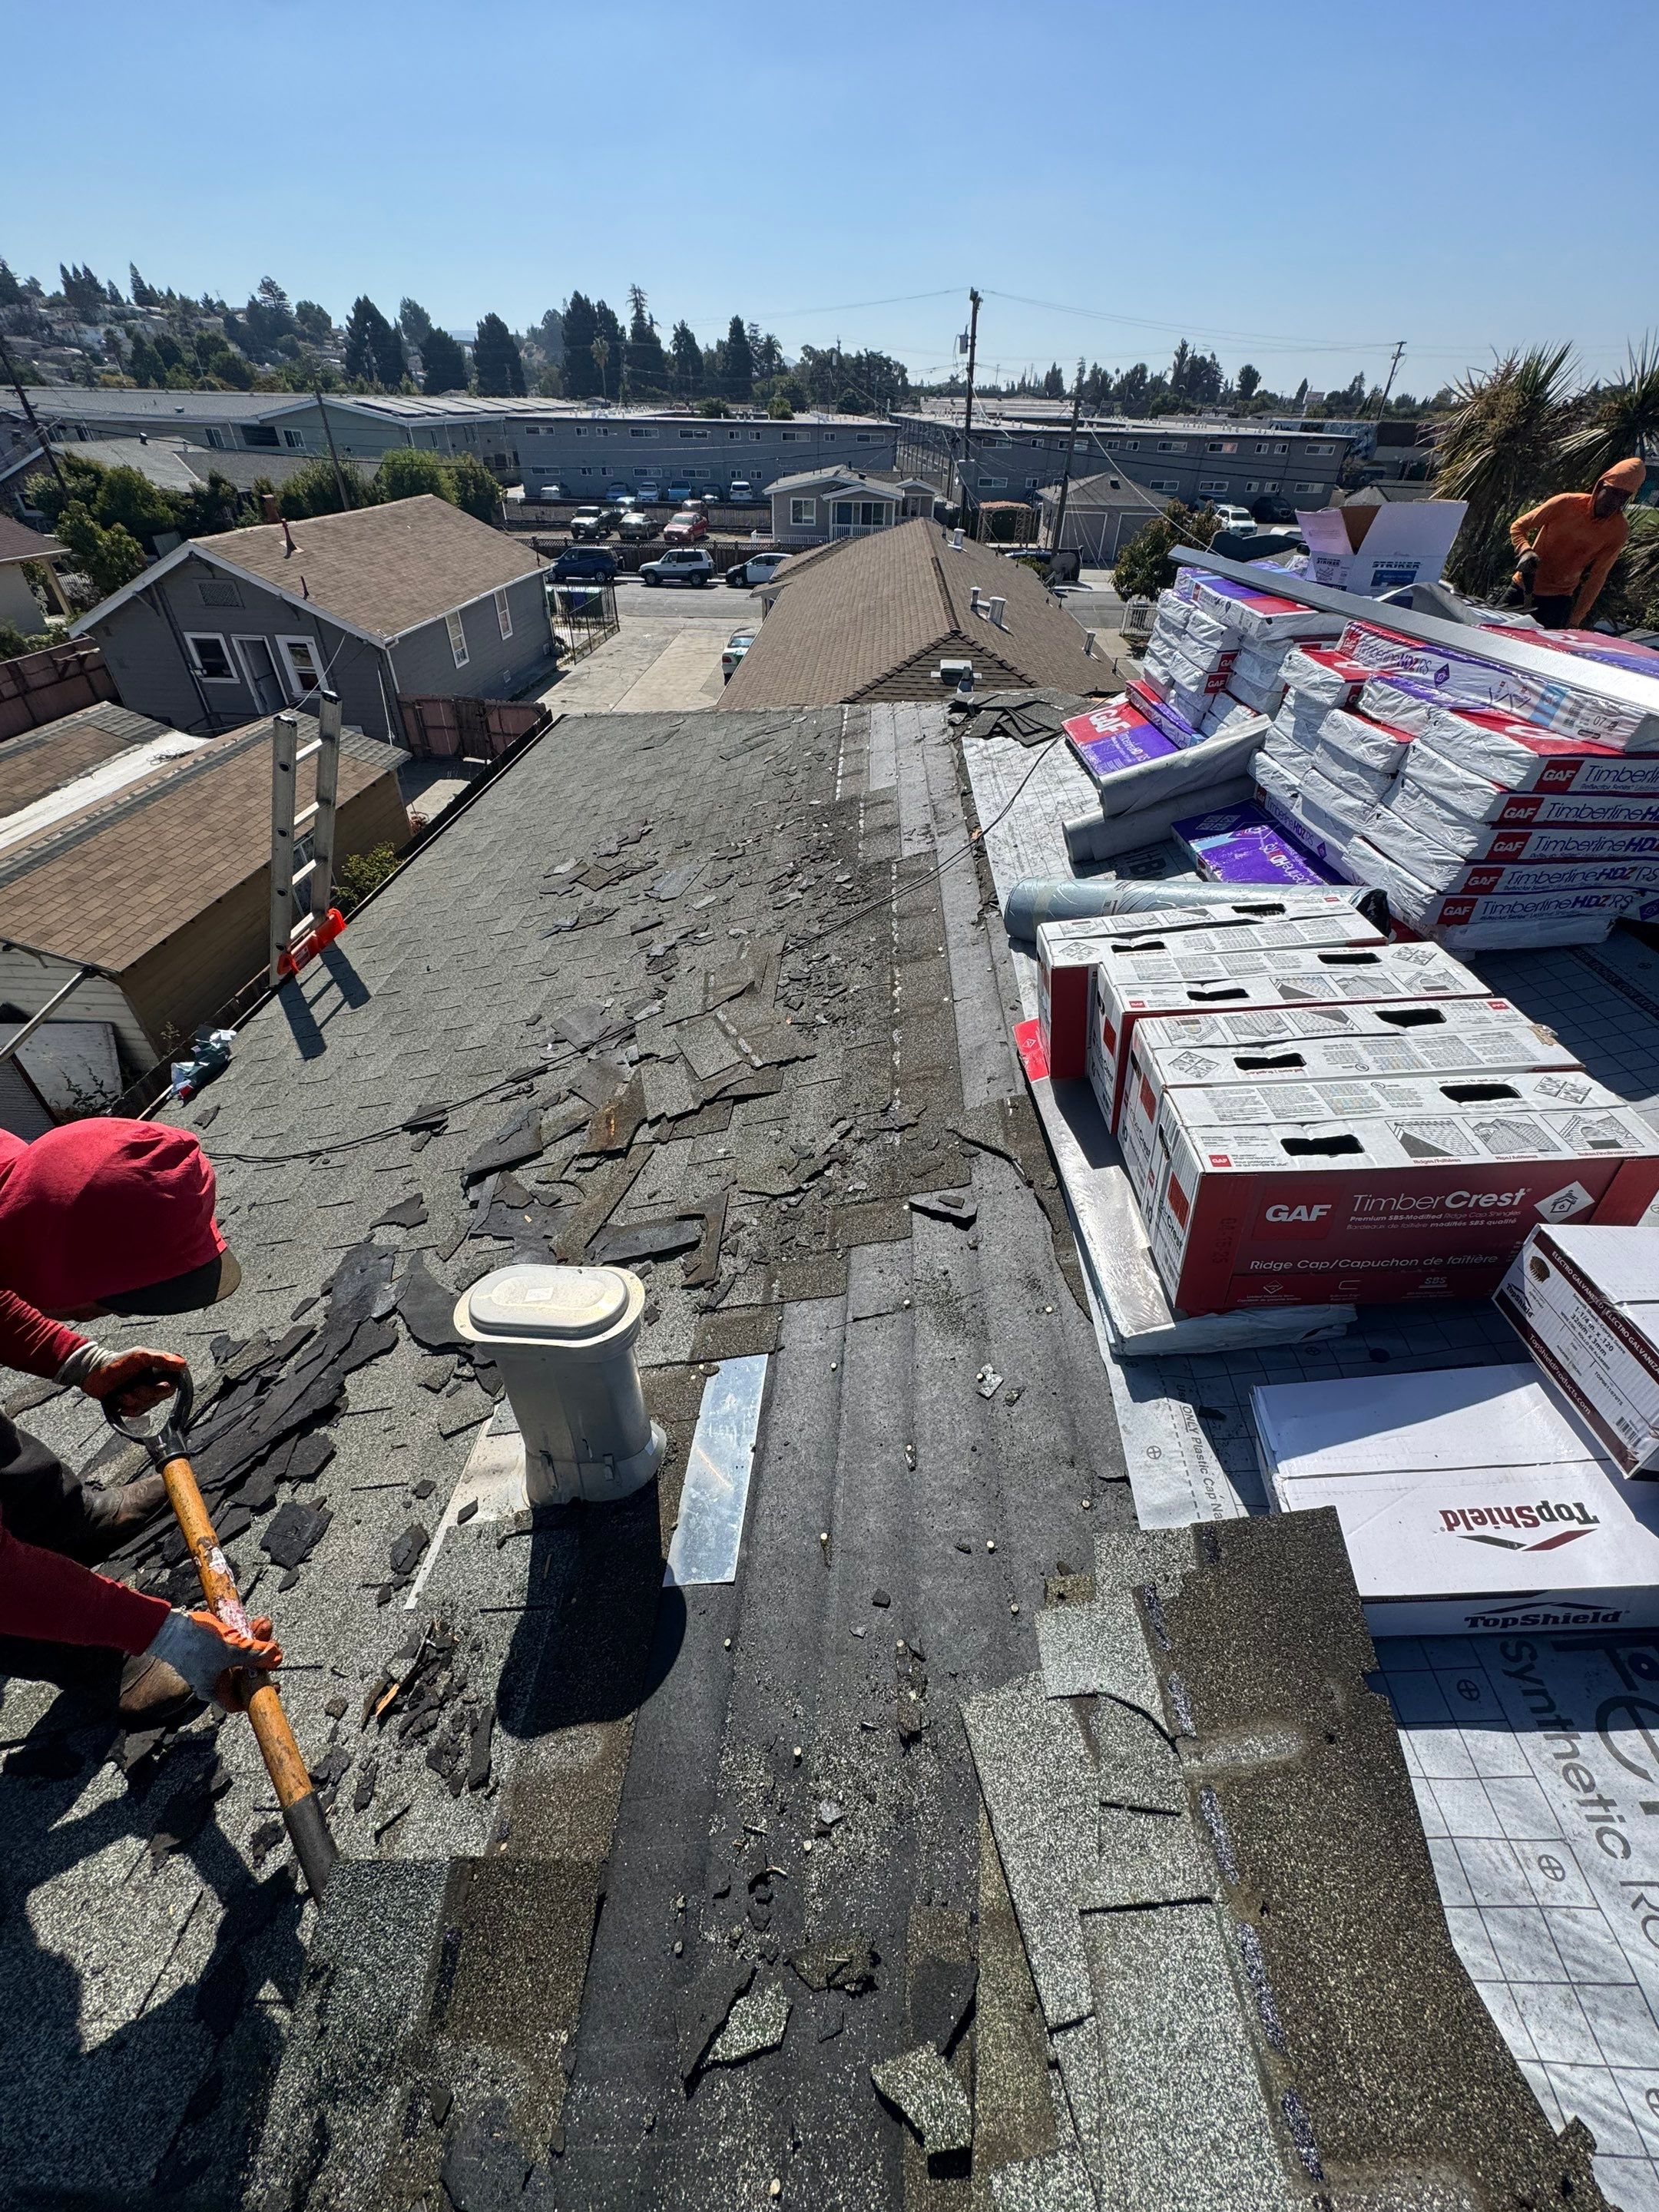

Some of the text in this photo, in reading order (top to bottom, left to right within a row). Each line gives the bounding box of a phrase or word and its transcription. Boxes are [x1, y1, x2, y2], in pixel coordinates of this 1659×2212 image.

[1372, 561, 1422, 569] STRIKER
[1207, 679, 1226, 688] GAF
[1089, 709, 1132, 733] GAF
[1542, 769, 1577, 782] GAF
[1503, 807, 1537, 819] GAF
[1493, 841, 1525, 853] GAF
[1467, 876, 1498, 887] GAF
[1443, 906, 1473, 916] GAF
[1266, 1188, 1527, 1222] GAF TimberCrest
[1388, 1213, 1443, 1221] SBS-Modified
[1486, 1217, 1518, 1227] qualité
[1250, 1254, 1499, 1272] Ridge Cap/Capuchon de faîtière
[1424, 1276, 1448, 1285] SBS
[1506, 1283, 1535, 1319] TopShield
[1551, 1250, 1575, 1276] ELECTRO
[1605, 1310, 1630, 1338] ELECTRO
[1570, 1313, 1588, 1335] 32mm
[1591, 1337, 1608, 1356] 3mm
[1575, 1306, 1590, 1324] 1-1/4
[1600, 1337, 1614, 1352] .120
[1528, 1333, 1592, 1416] TopShieldProducts.com
[1176, 1385, 1224, 1520] Use ONLY Plastic Cap Na
[1439, 1500, 1601, 1532] TopShield
[1464, 1611, 1623, 1629] TopShield
[1499, 1638, 1632, 1861] Synthetic
